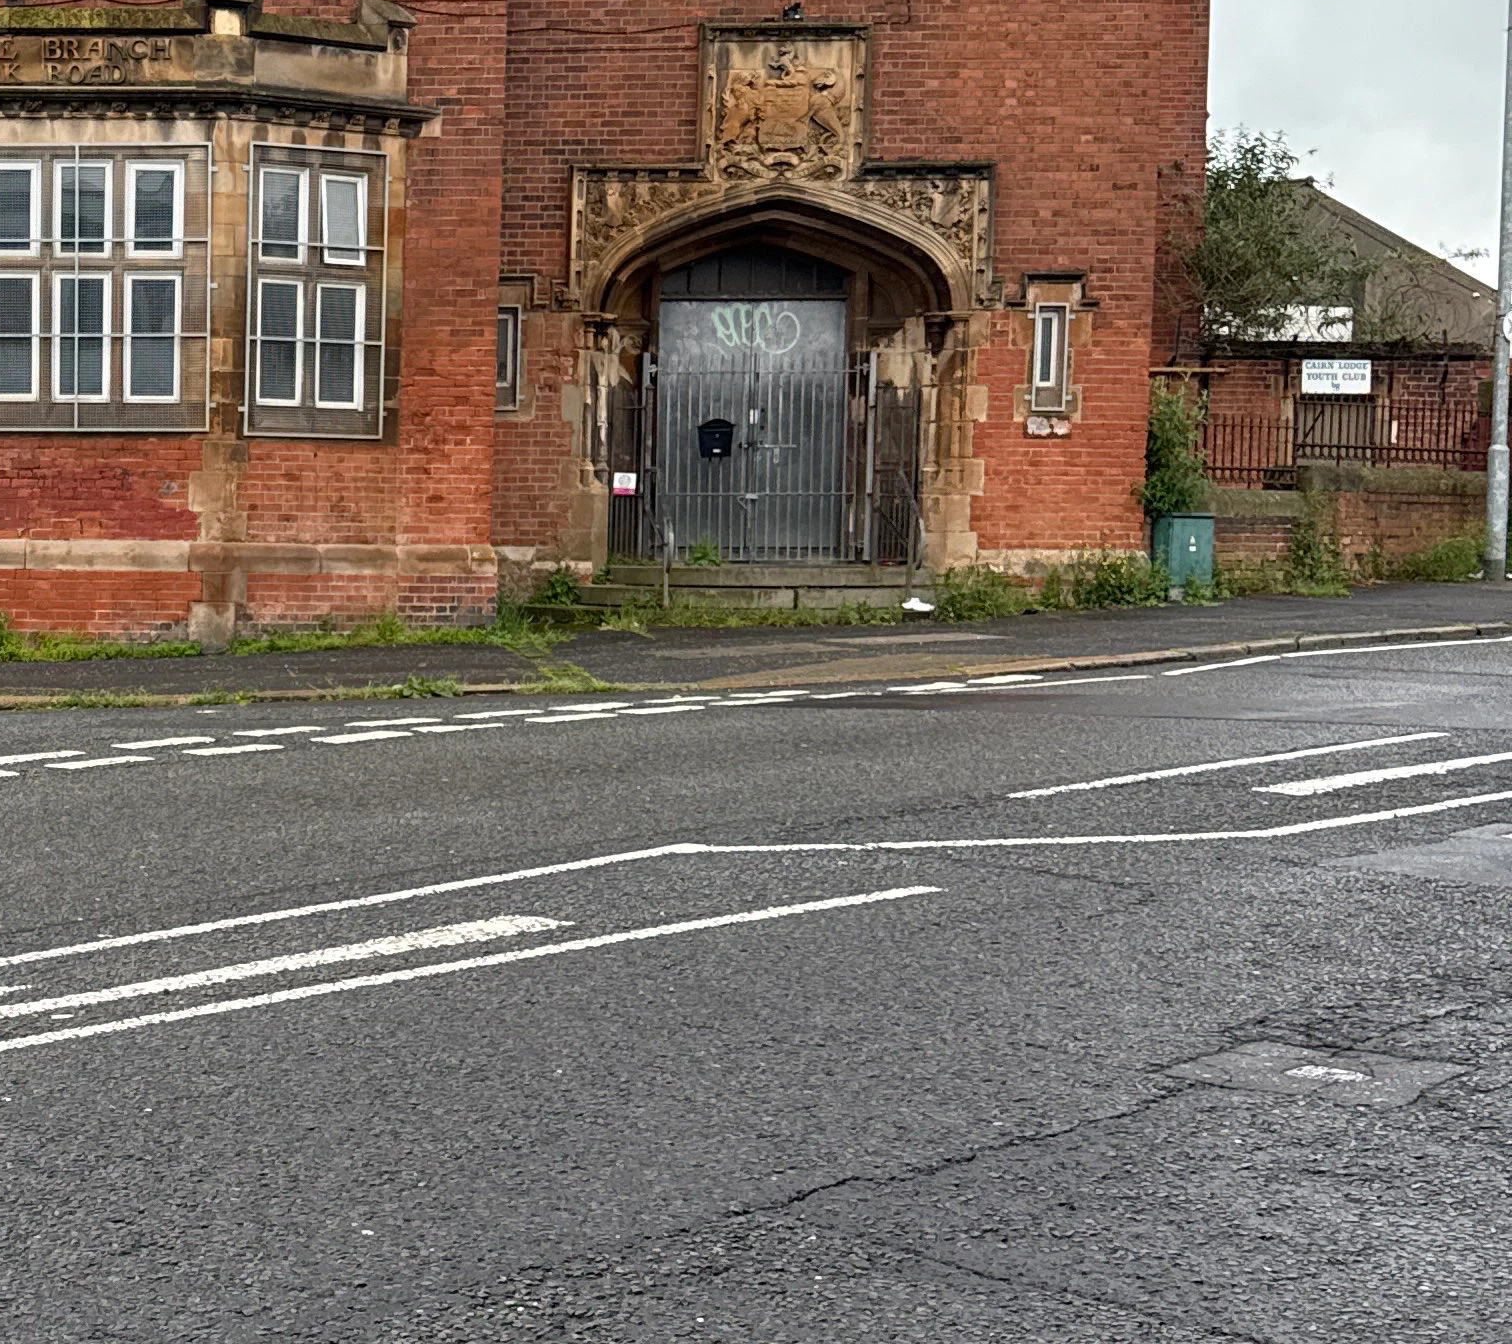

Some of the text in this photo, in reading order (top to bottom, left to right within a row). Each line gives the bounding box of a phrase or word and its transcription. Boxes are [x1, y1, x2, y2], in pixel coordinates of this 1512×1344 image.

[43, 37, 172, 61] BRANCH
[44, 62, 128, 84] ROAD
[1305, 361, 1369, 370] CAIRN LODGE
[1306, 372, 1367, 381] YOUTH CLUB
